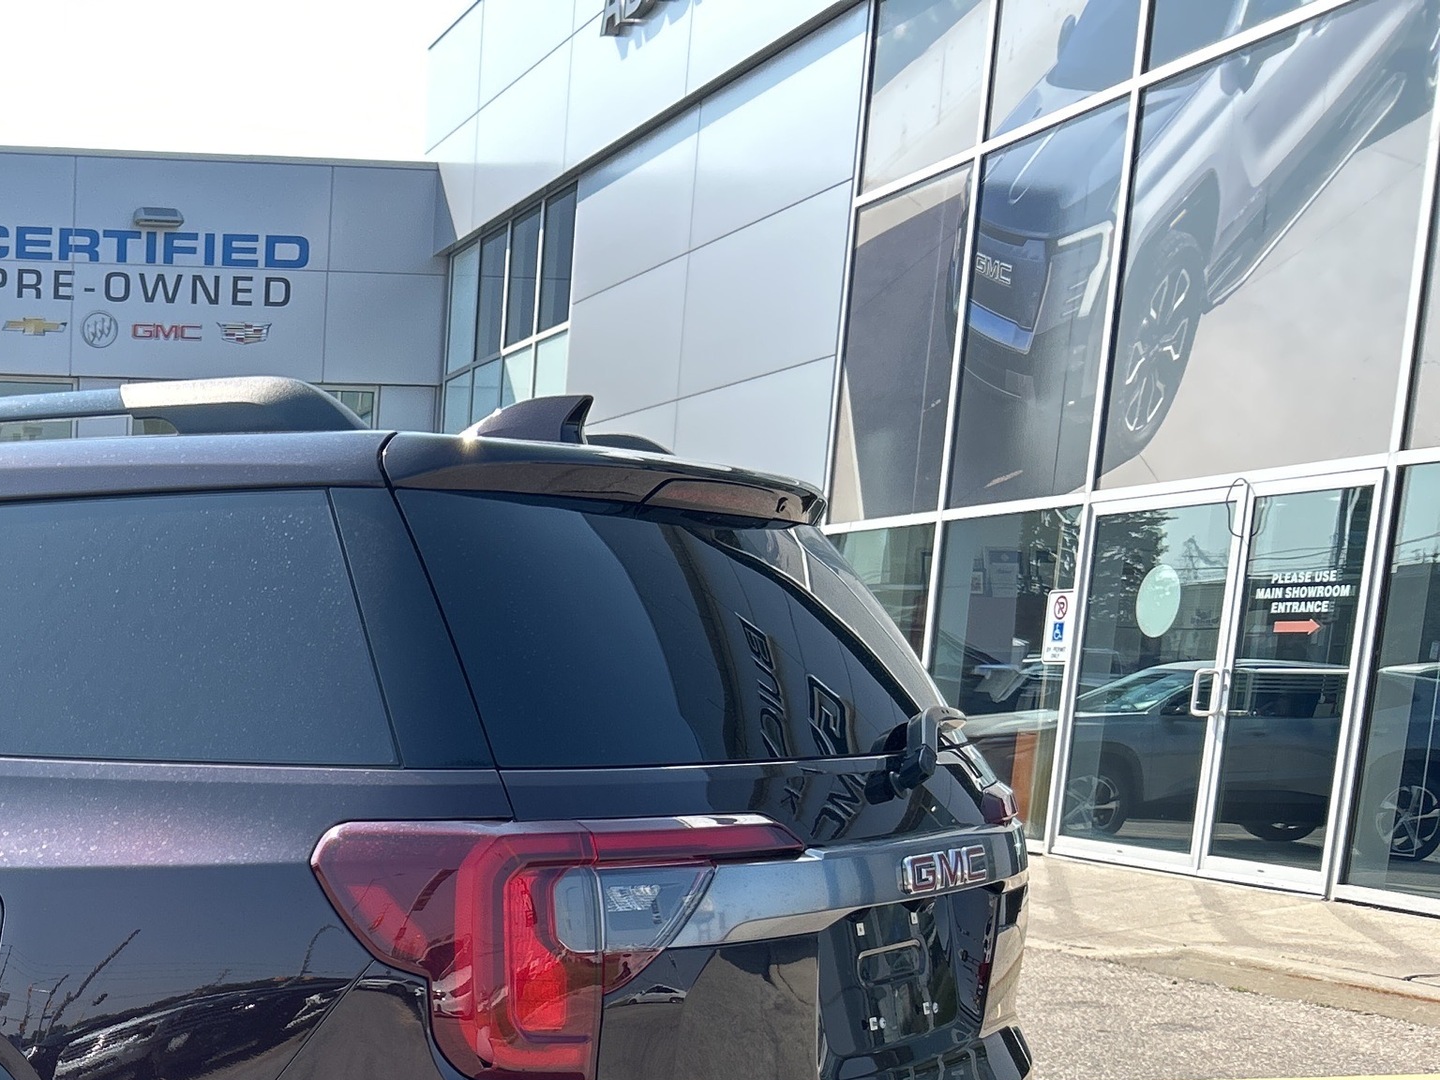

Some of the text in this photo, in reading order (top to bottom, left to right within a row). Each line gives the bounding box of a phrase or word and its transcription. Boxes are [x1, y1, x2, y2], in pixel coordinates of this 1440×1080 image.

[975, 251, 1013, 285] GMC
[131, 322, 203, 343] GMC
[1270, 570, 1337, 584] PLEASE USE
[1255, 585, 1351, 599] MAIN SHOWROOM
[1270, 601, 1330, 613] ENTRANCE
[901, 844, 987, 895] GMC
